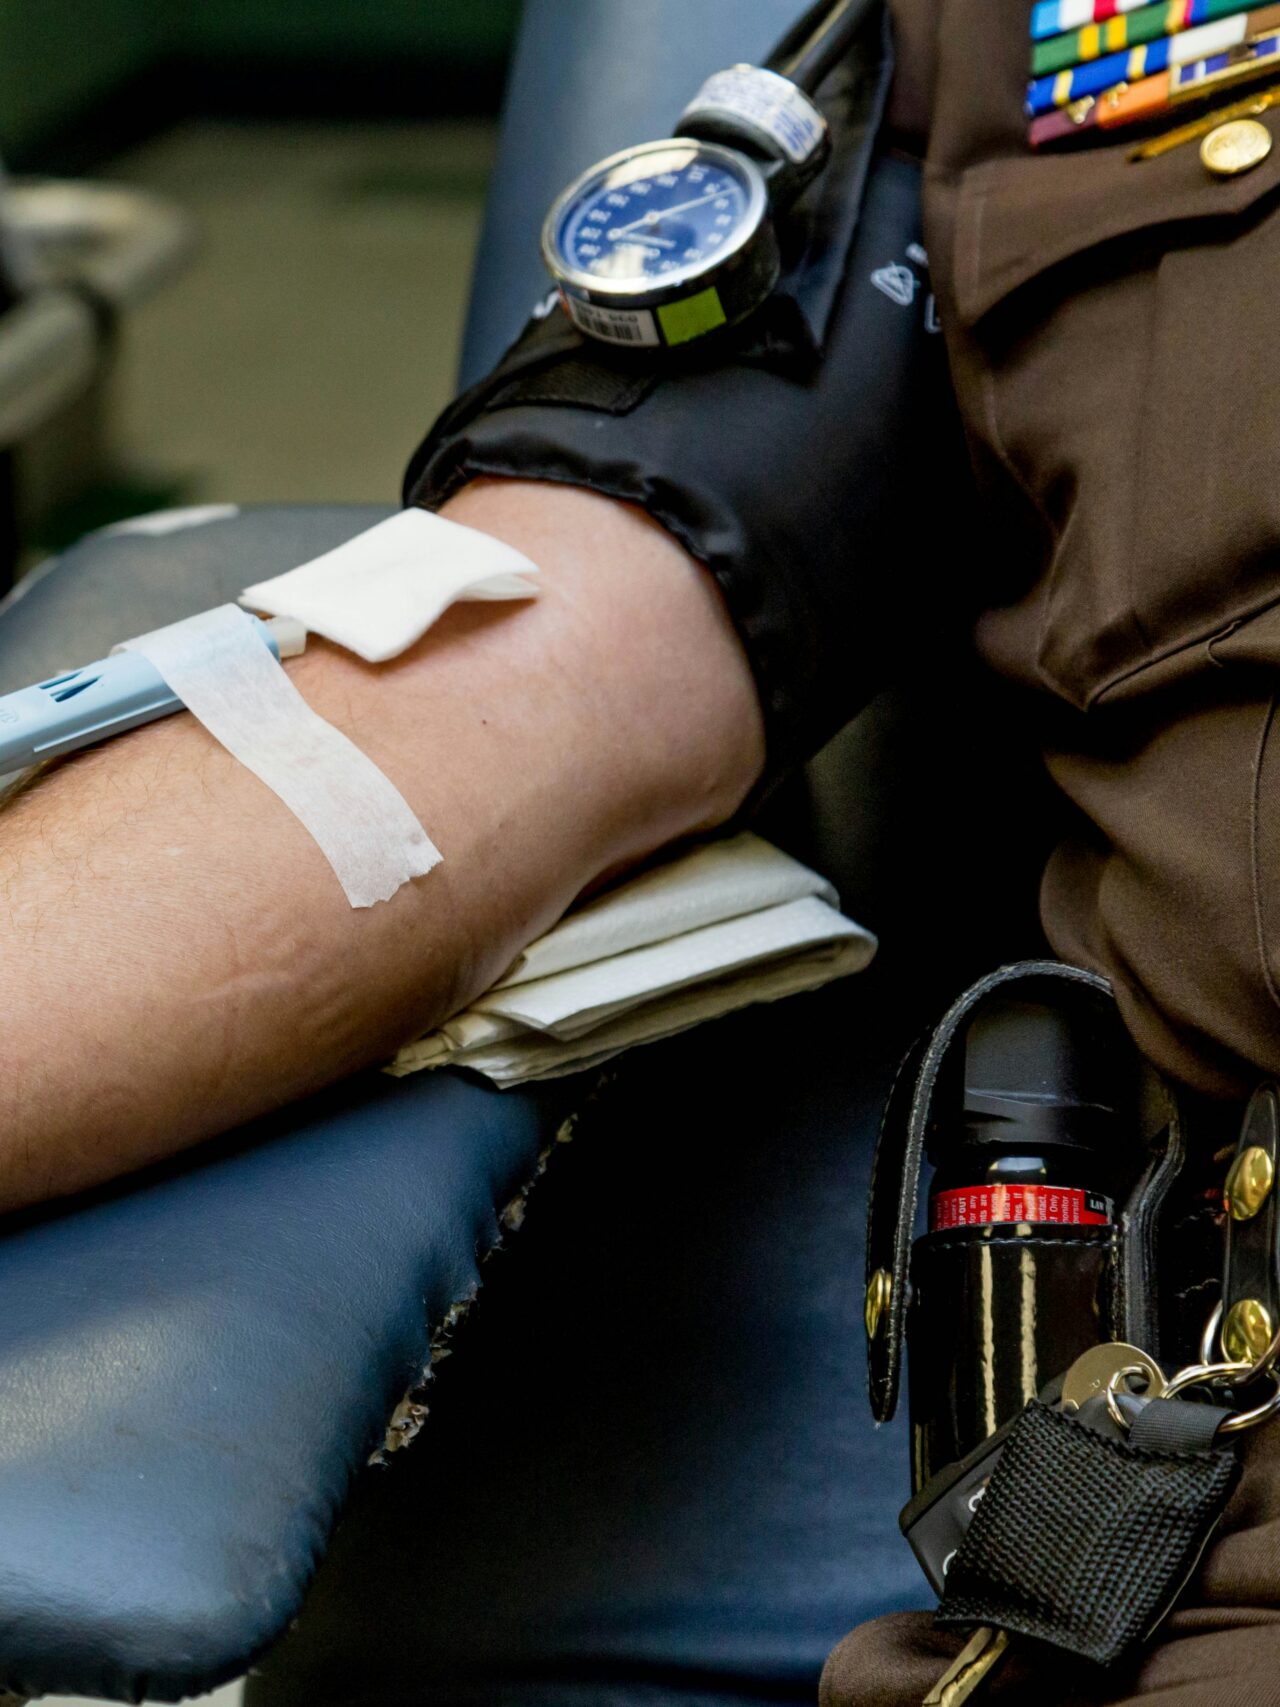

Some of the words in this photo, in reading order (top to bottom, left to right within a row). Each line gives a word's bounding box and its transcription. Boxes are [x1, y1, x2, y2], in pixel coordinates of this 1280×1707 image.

[958, 1197, 966, 1214] OUT
[969, 1195, 978, 1209] any
[1038, 1194, 1047, 1221] ontact.
[1049, 1194, 1060, 1213] Only
[958, 1215, 966, 1225] EP
